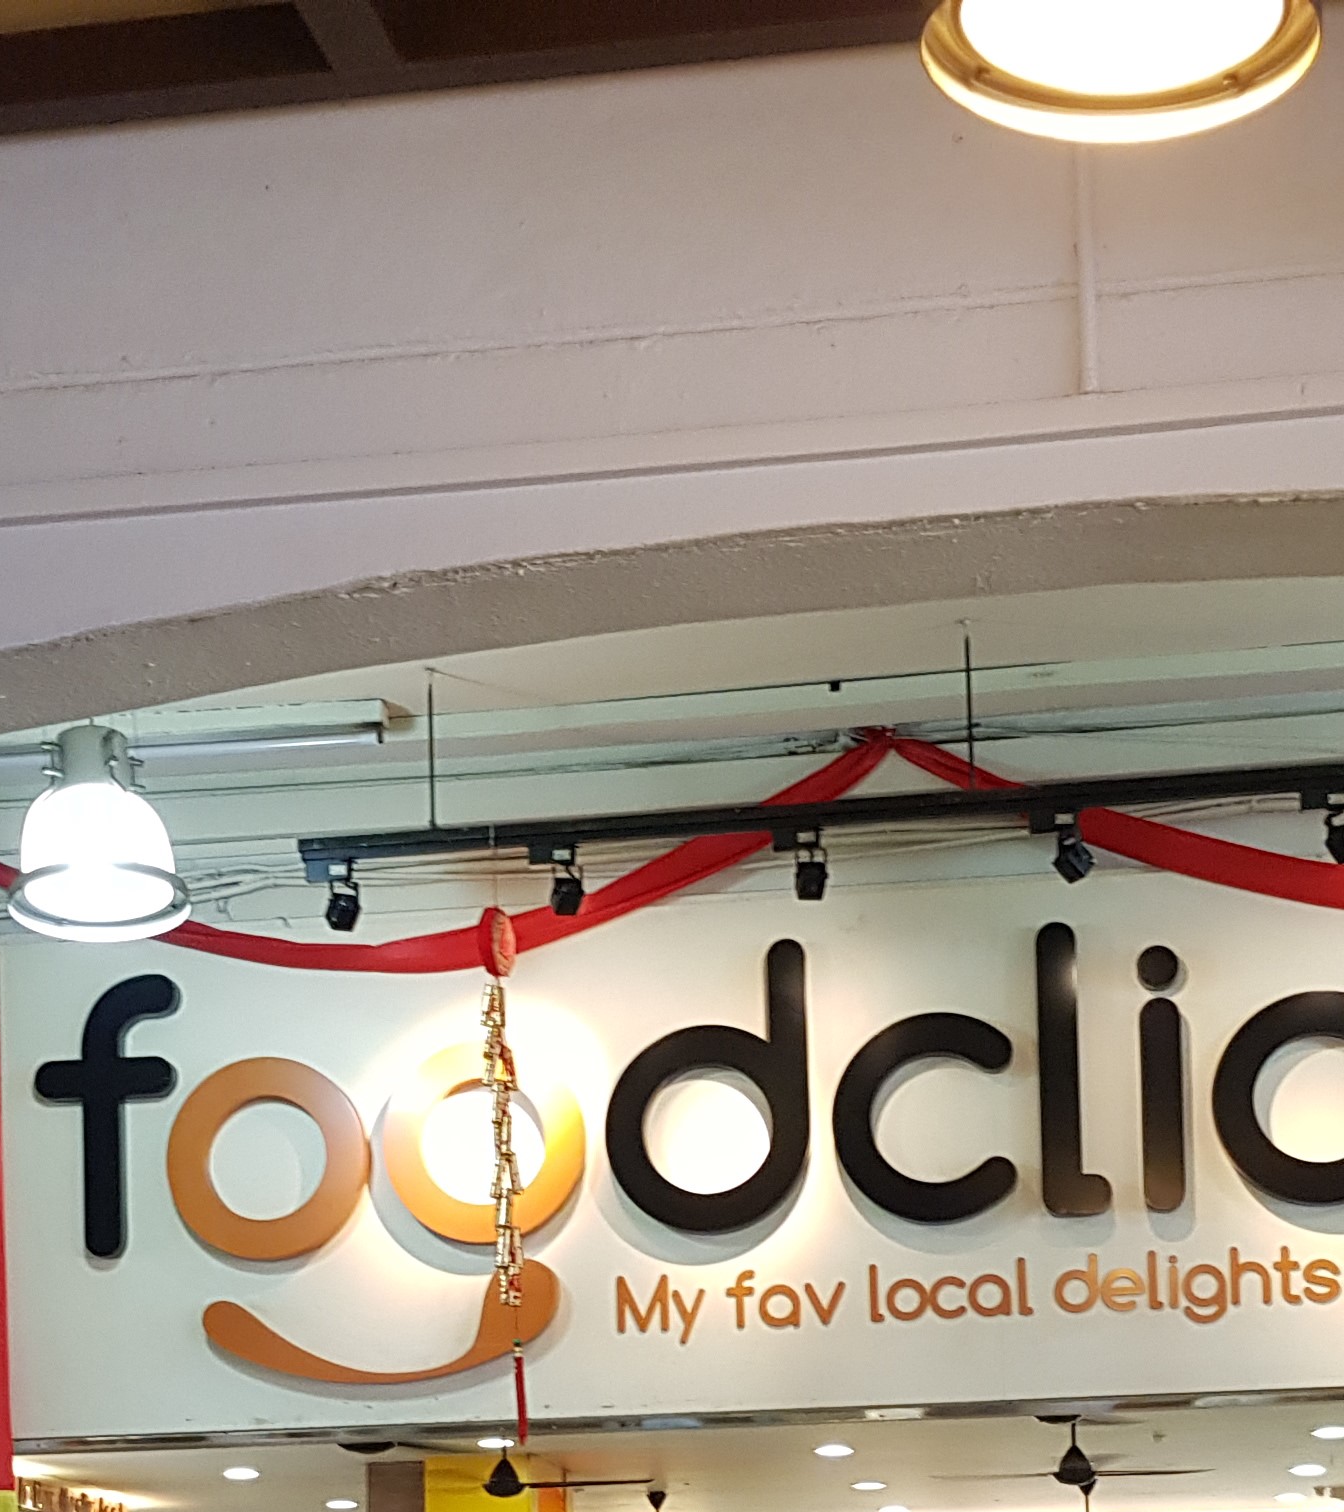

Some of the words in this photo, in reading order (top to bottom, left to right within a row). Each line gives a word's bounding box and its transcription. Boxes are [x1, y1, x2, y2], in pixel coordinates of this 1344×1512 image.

[616, 1273, 706, 1345] My
[726, 1269, 846, 1330] fav
[868, 1256, 1033, 1323] local
[1054, 1246, 1343, 1325] delights
